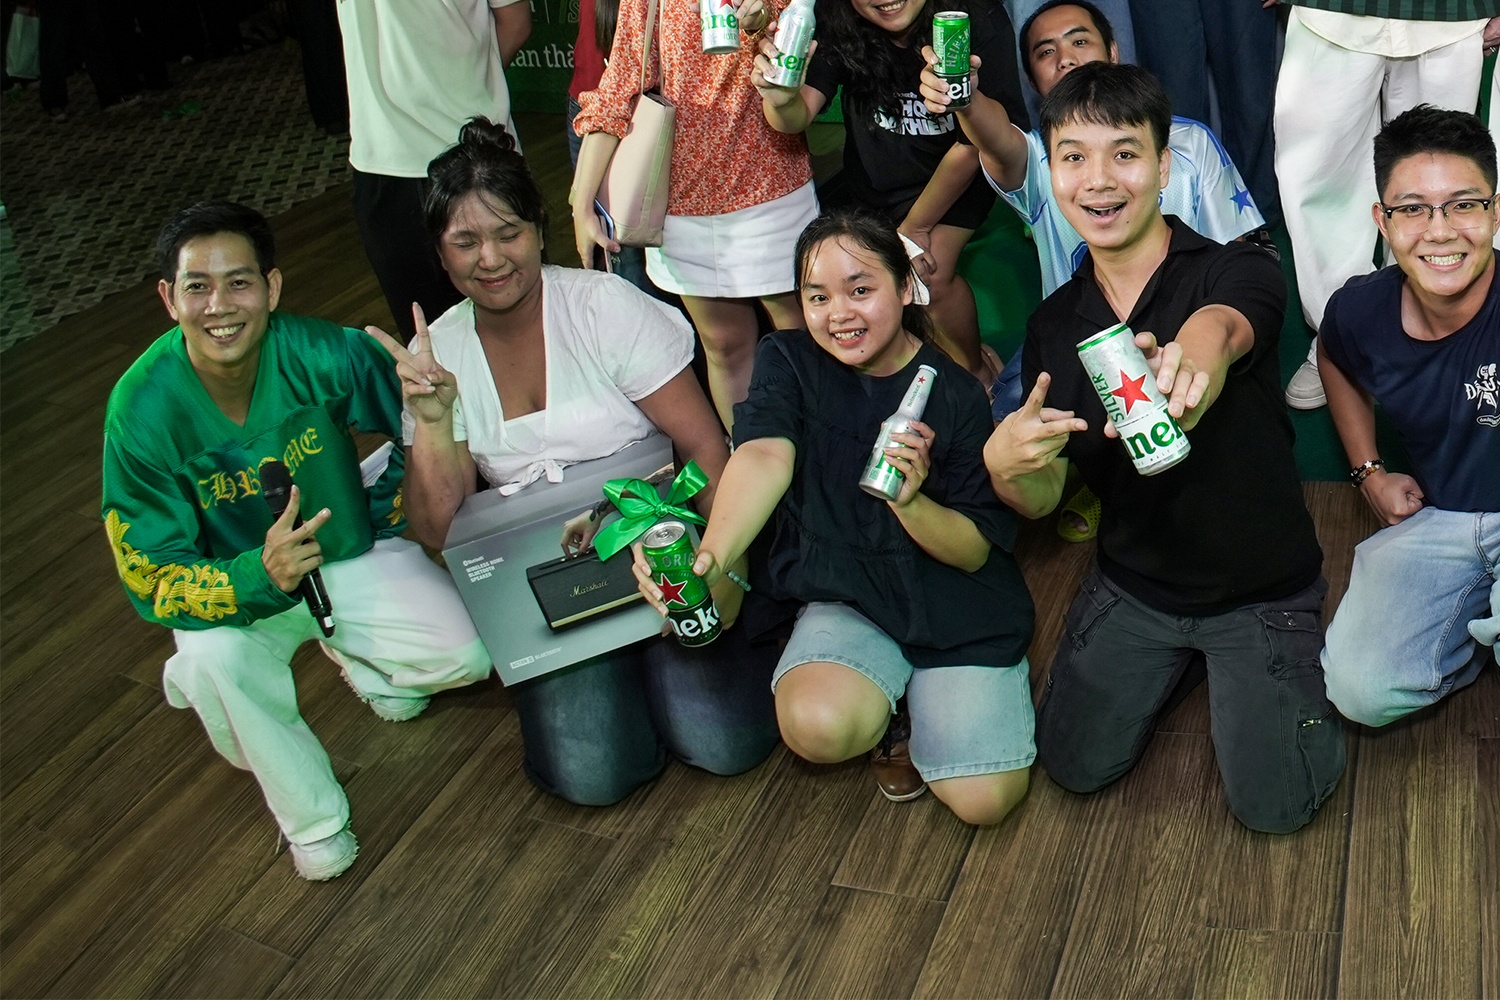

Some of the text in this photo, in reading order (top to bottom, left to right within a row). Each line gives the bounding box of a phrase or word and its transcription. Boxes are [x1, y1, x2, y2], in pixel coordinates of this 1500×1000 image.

[1091, 372, 1125, 423] SILVER
[198, 427, 323, 510] CHRME
[570, 578, 610, 598] Marshall
